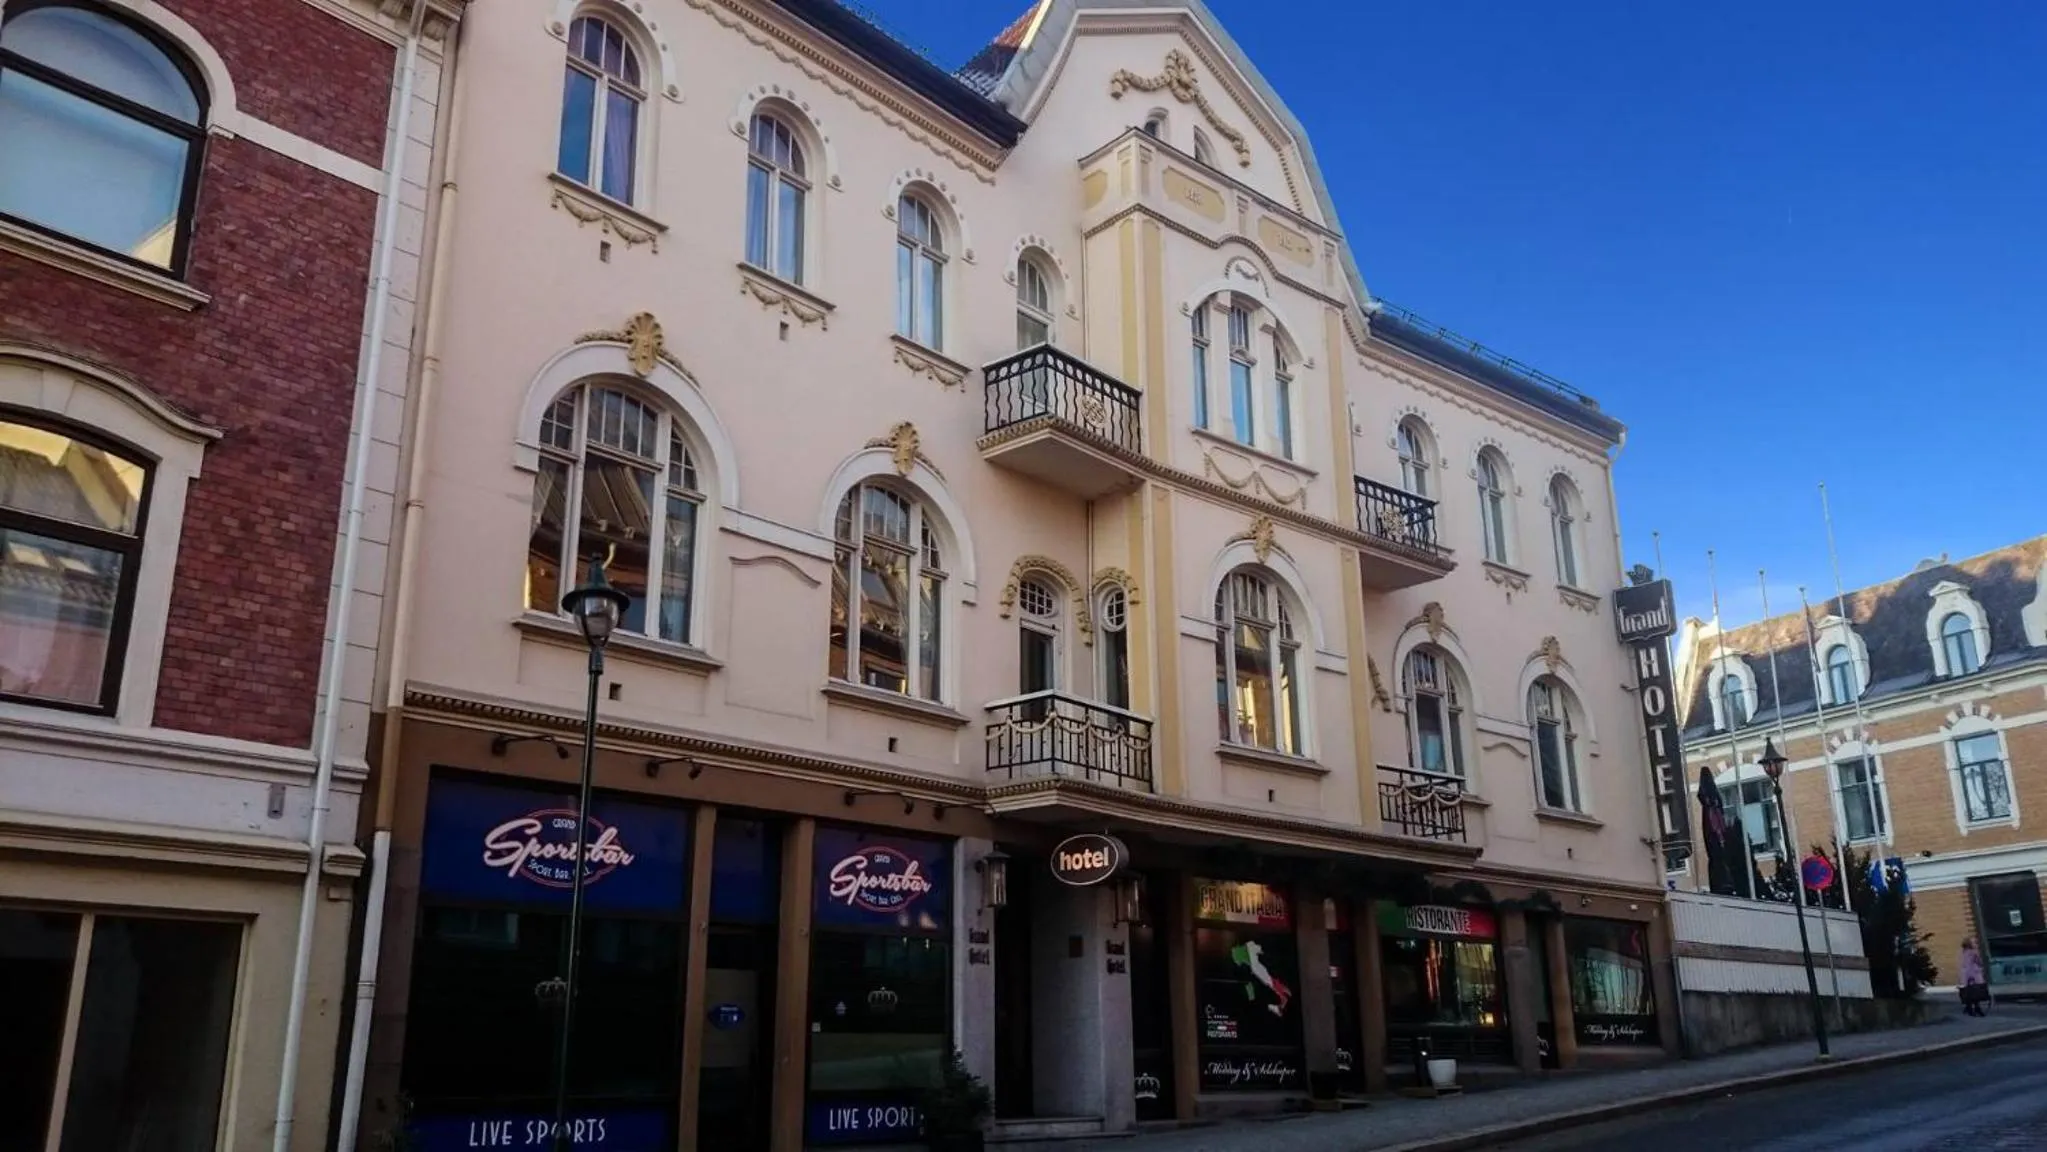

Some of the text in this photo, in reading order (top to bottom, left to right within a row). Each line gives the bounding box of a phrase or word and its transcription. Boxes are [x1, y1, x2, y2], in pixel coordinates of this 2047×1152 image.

[1639, 647, 1680, 835] HOTEL
[1059, 846, 1110, 871] hotel
[830, 855, 933, 906] Sportsbar
[1406, 906, 1472, 935] RISTORANTE
[829, 1105, 919, 1131] LIVE SPORT
[469, 1120, 513, 1147] LIVE
